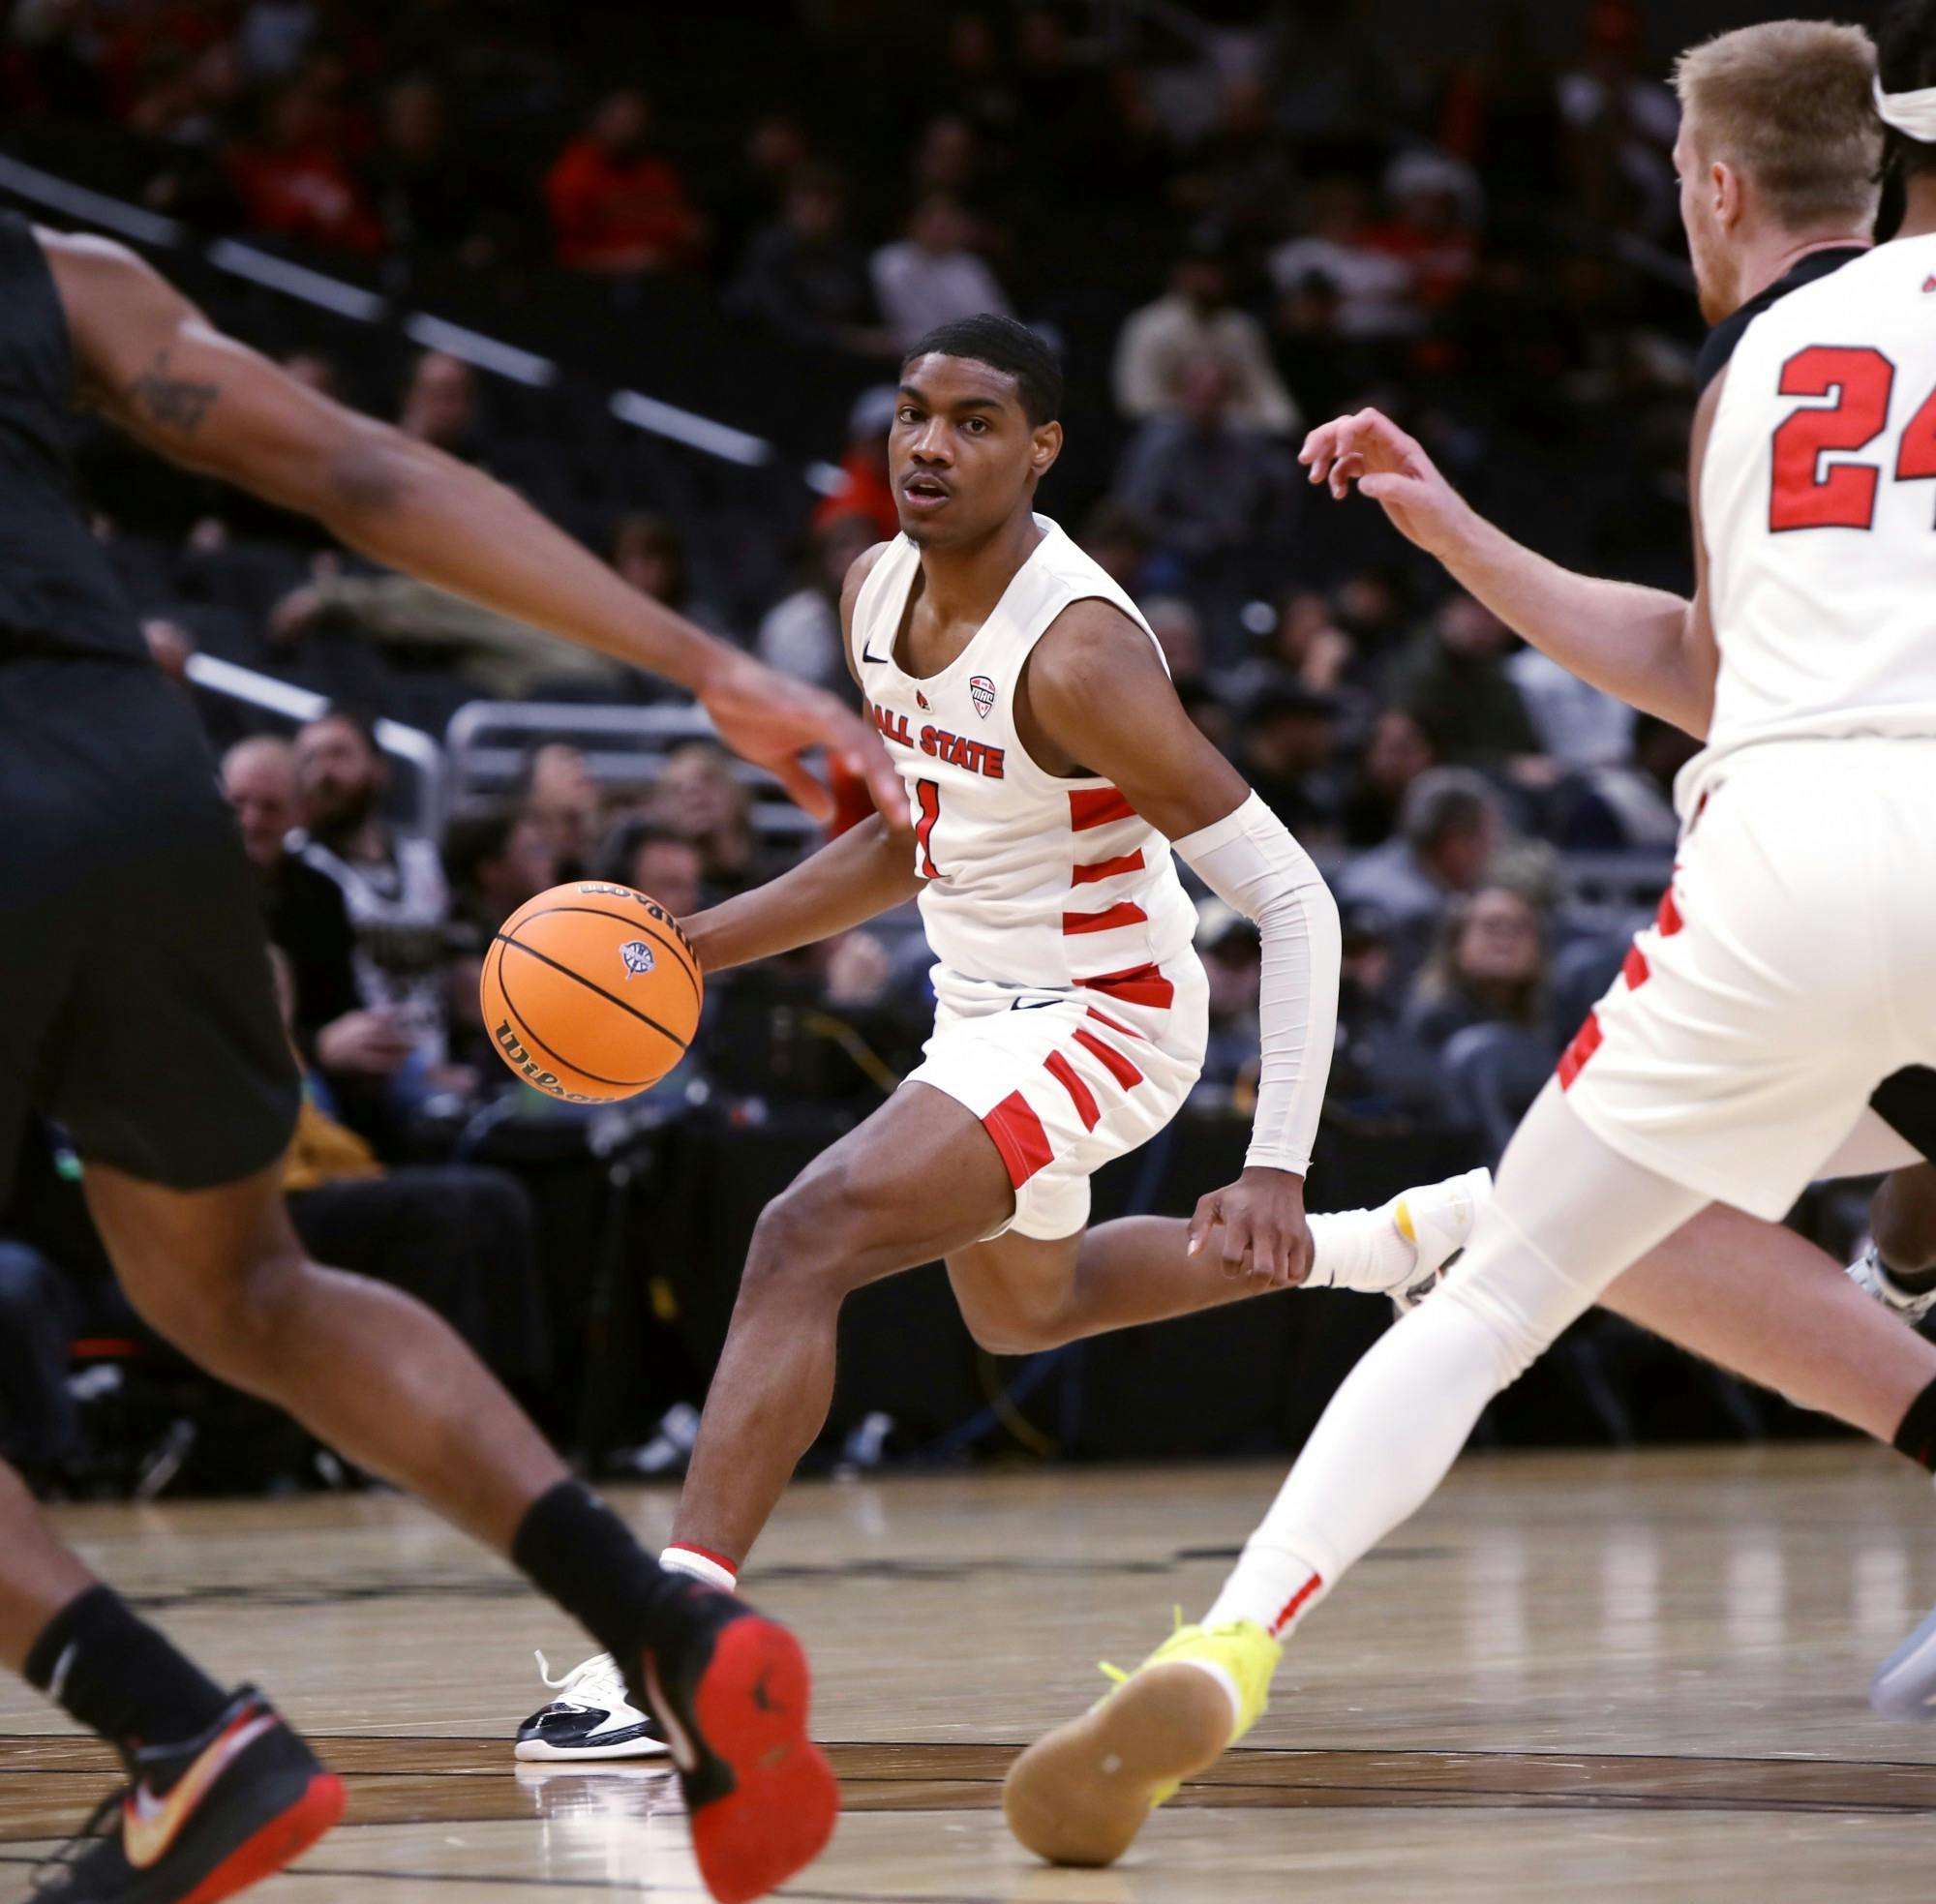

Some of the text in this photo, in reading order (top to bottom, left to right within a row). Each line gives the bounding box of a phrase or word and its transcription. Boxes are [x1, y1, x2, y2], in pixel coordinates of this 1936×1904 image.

[972, 686, 993, 704] MAC
[874, 704, 1005, 779] ALL STATE
[916, 777, 951, 879] 1
